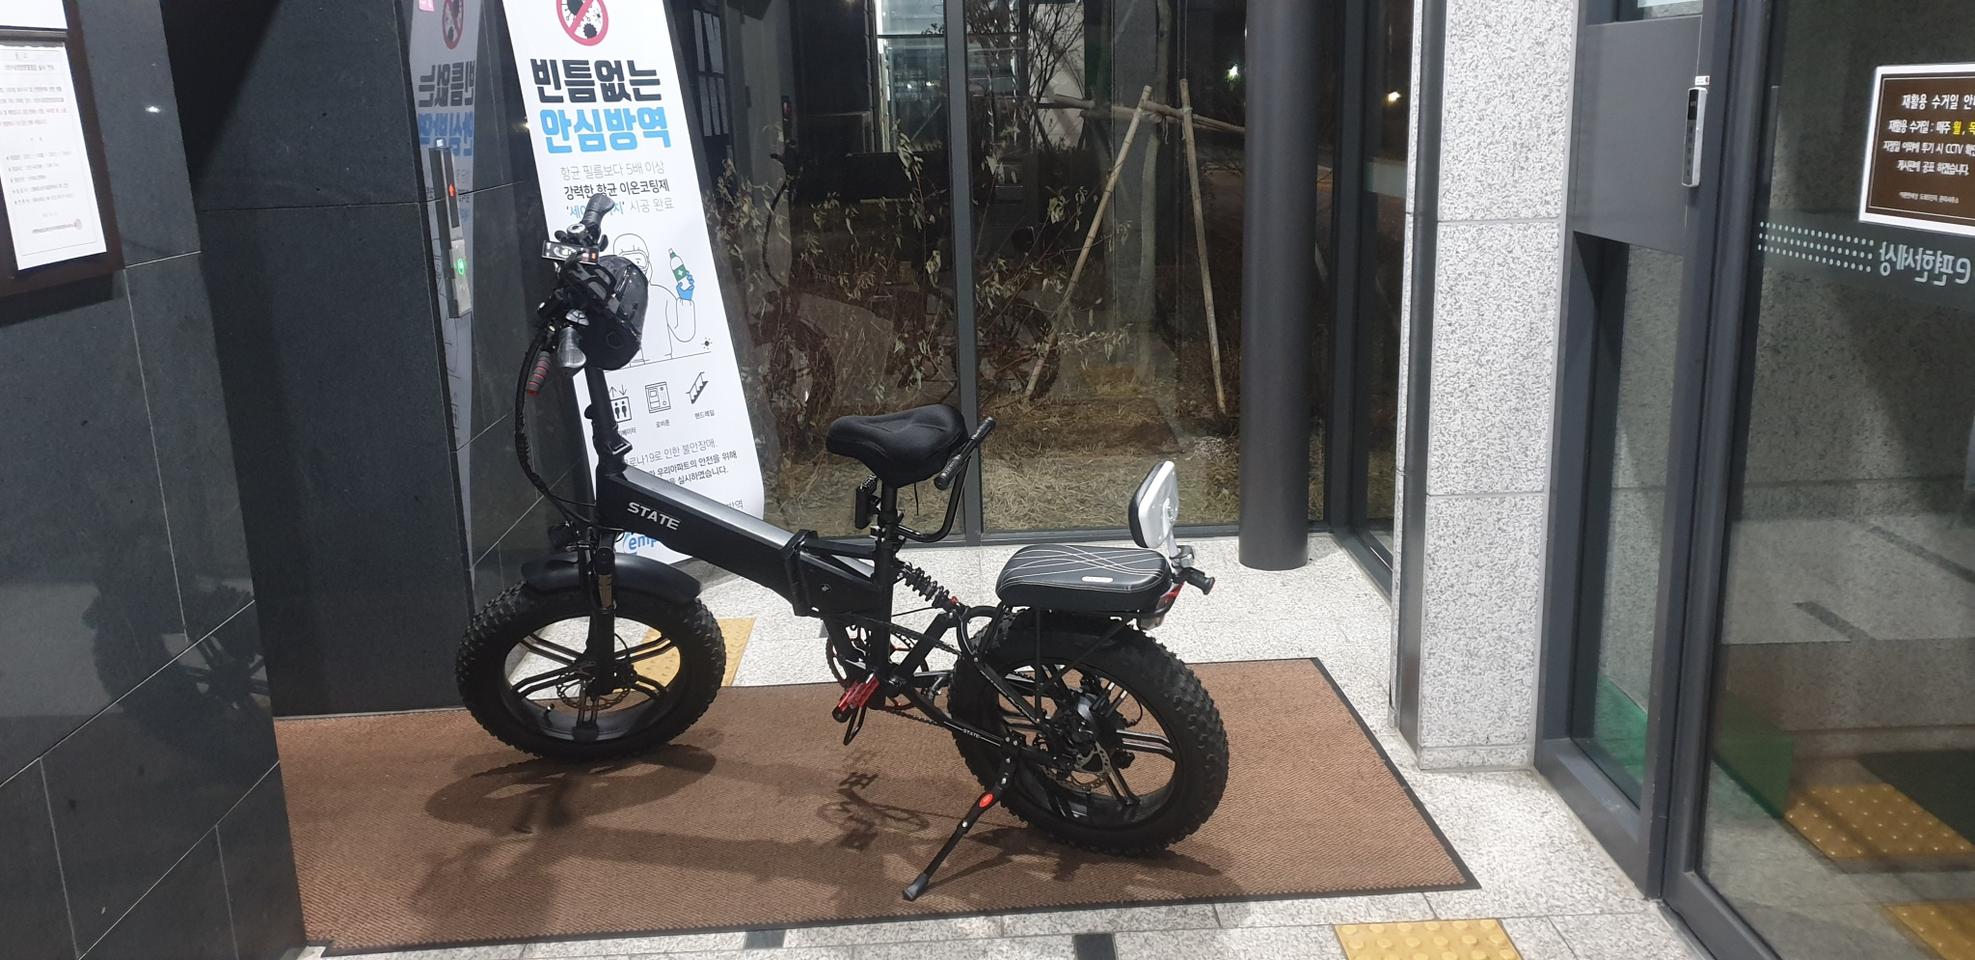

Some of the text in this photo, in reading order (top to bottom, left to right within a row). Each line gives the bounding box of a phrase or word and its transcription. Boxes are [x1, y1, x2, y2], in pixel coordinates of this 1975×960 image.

[530, 58, 662, 104] 빈틈없는
[1901, 93, 1975, 110] 재활용 수거일 안
[539, 106, 671, 154] 안심방역
[1945, 143, 1964, 154] CCTV
[560, 160, 664, 181] 항균 필름보다 5배 이상
[564, 179, 670, 201] 강력한 항균 이온코팅제
[630, 199, 650, 213] 시공
[653, 197, 675, 211] 완료
[657, 460, 698, 477] 우리아파트의
[698, 453, 720, 467] 안전을
[722, 450, 738, 462] 위해
[664, 447, 681, 459] 인한
[678, 466, 729, 484] 실시하였습니다.
[627, 502, 680, 531] STATE
